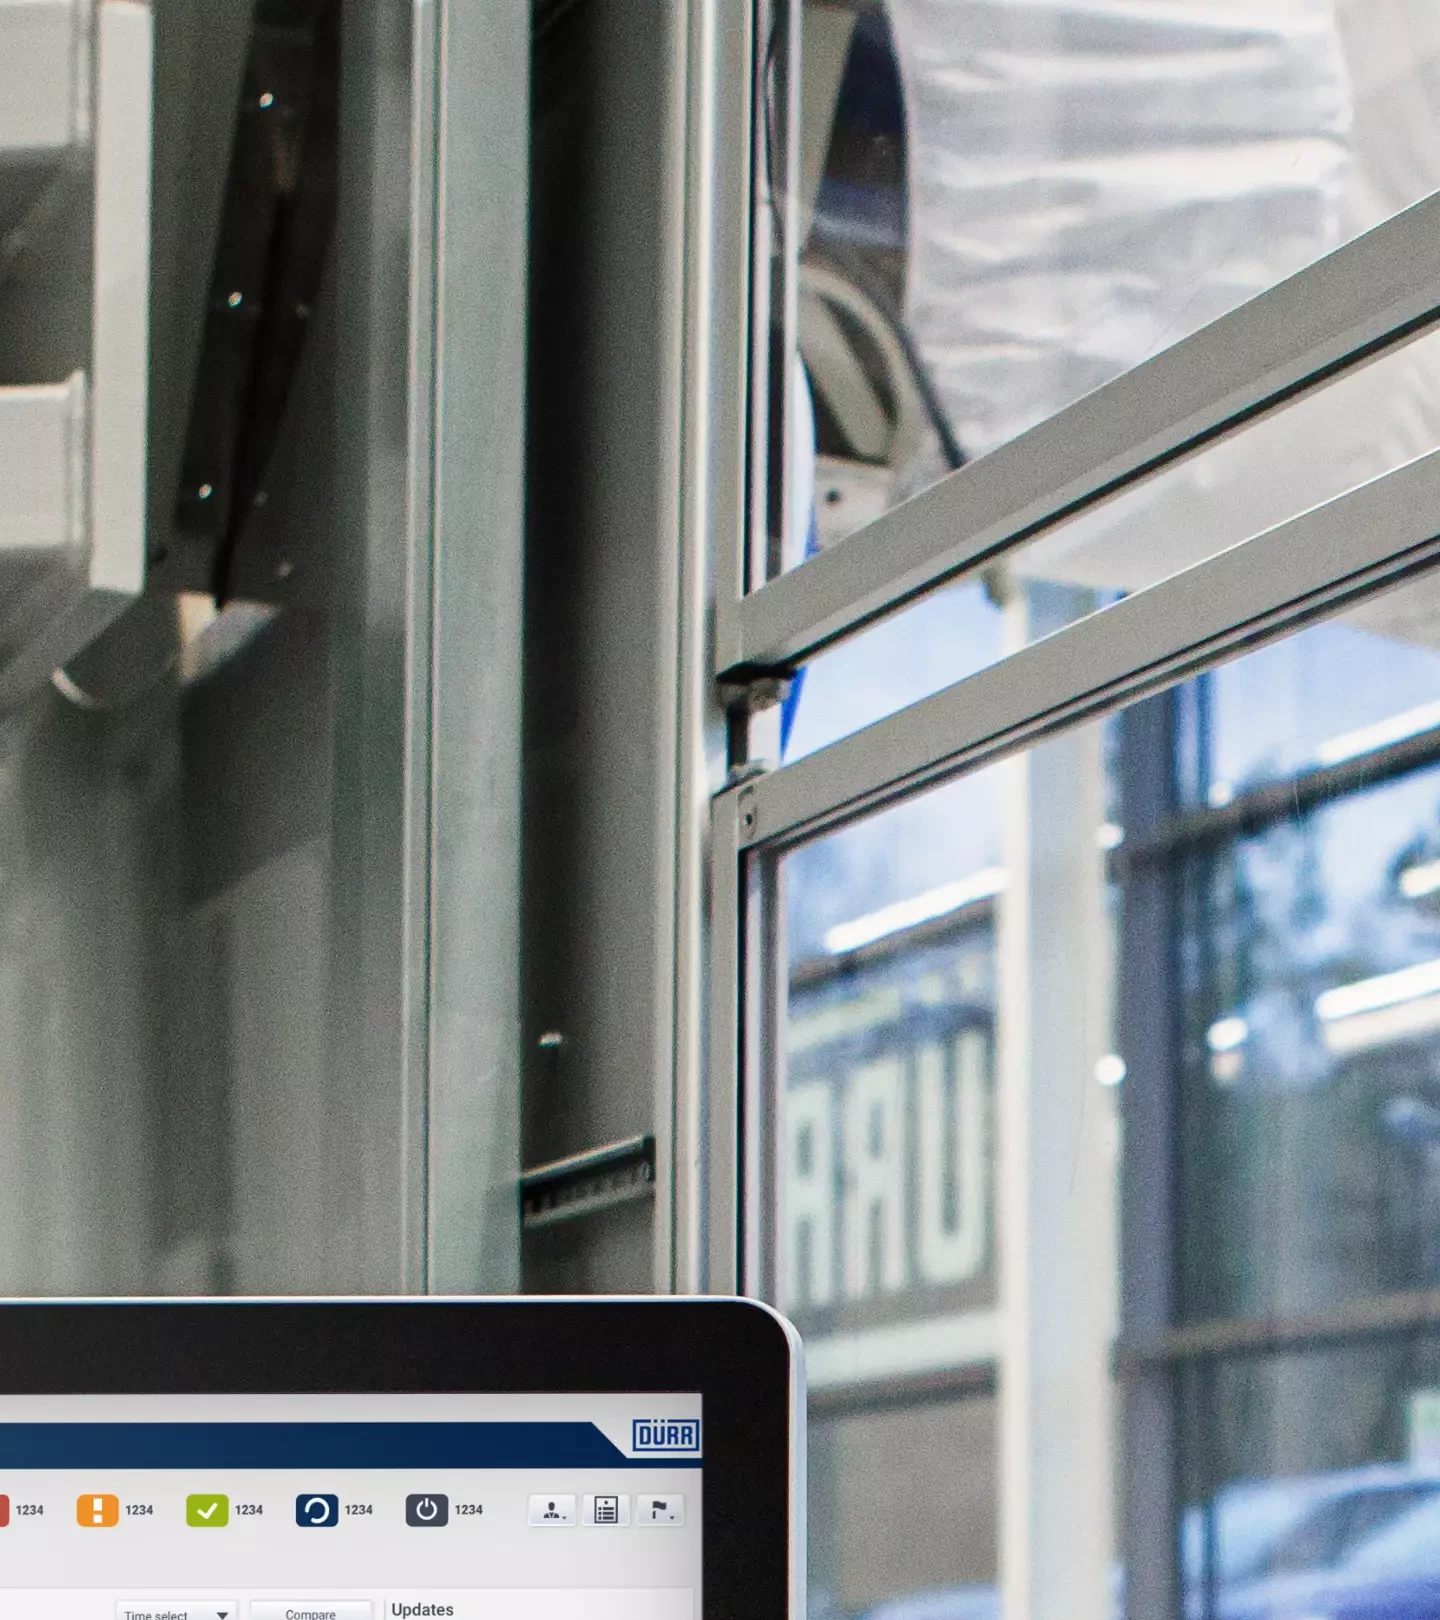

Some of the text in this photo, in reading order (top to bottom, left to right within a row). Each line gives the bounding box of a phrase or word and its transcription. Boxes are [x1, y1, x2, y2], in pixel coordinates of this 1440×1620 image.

[639, 1419, 693, 1445] DÜRR
[15, 1504, 44, 1516] 1234
[125, 1504, 154, 1516] 1234
[235, 1504, 263, 1516] 1234
[345, 1504, 373, 1516] 1234
[455, 1504, 484, 1515] 1234
[391, 1602, 454, 1619] Updates
